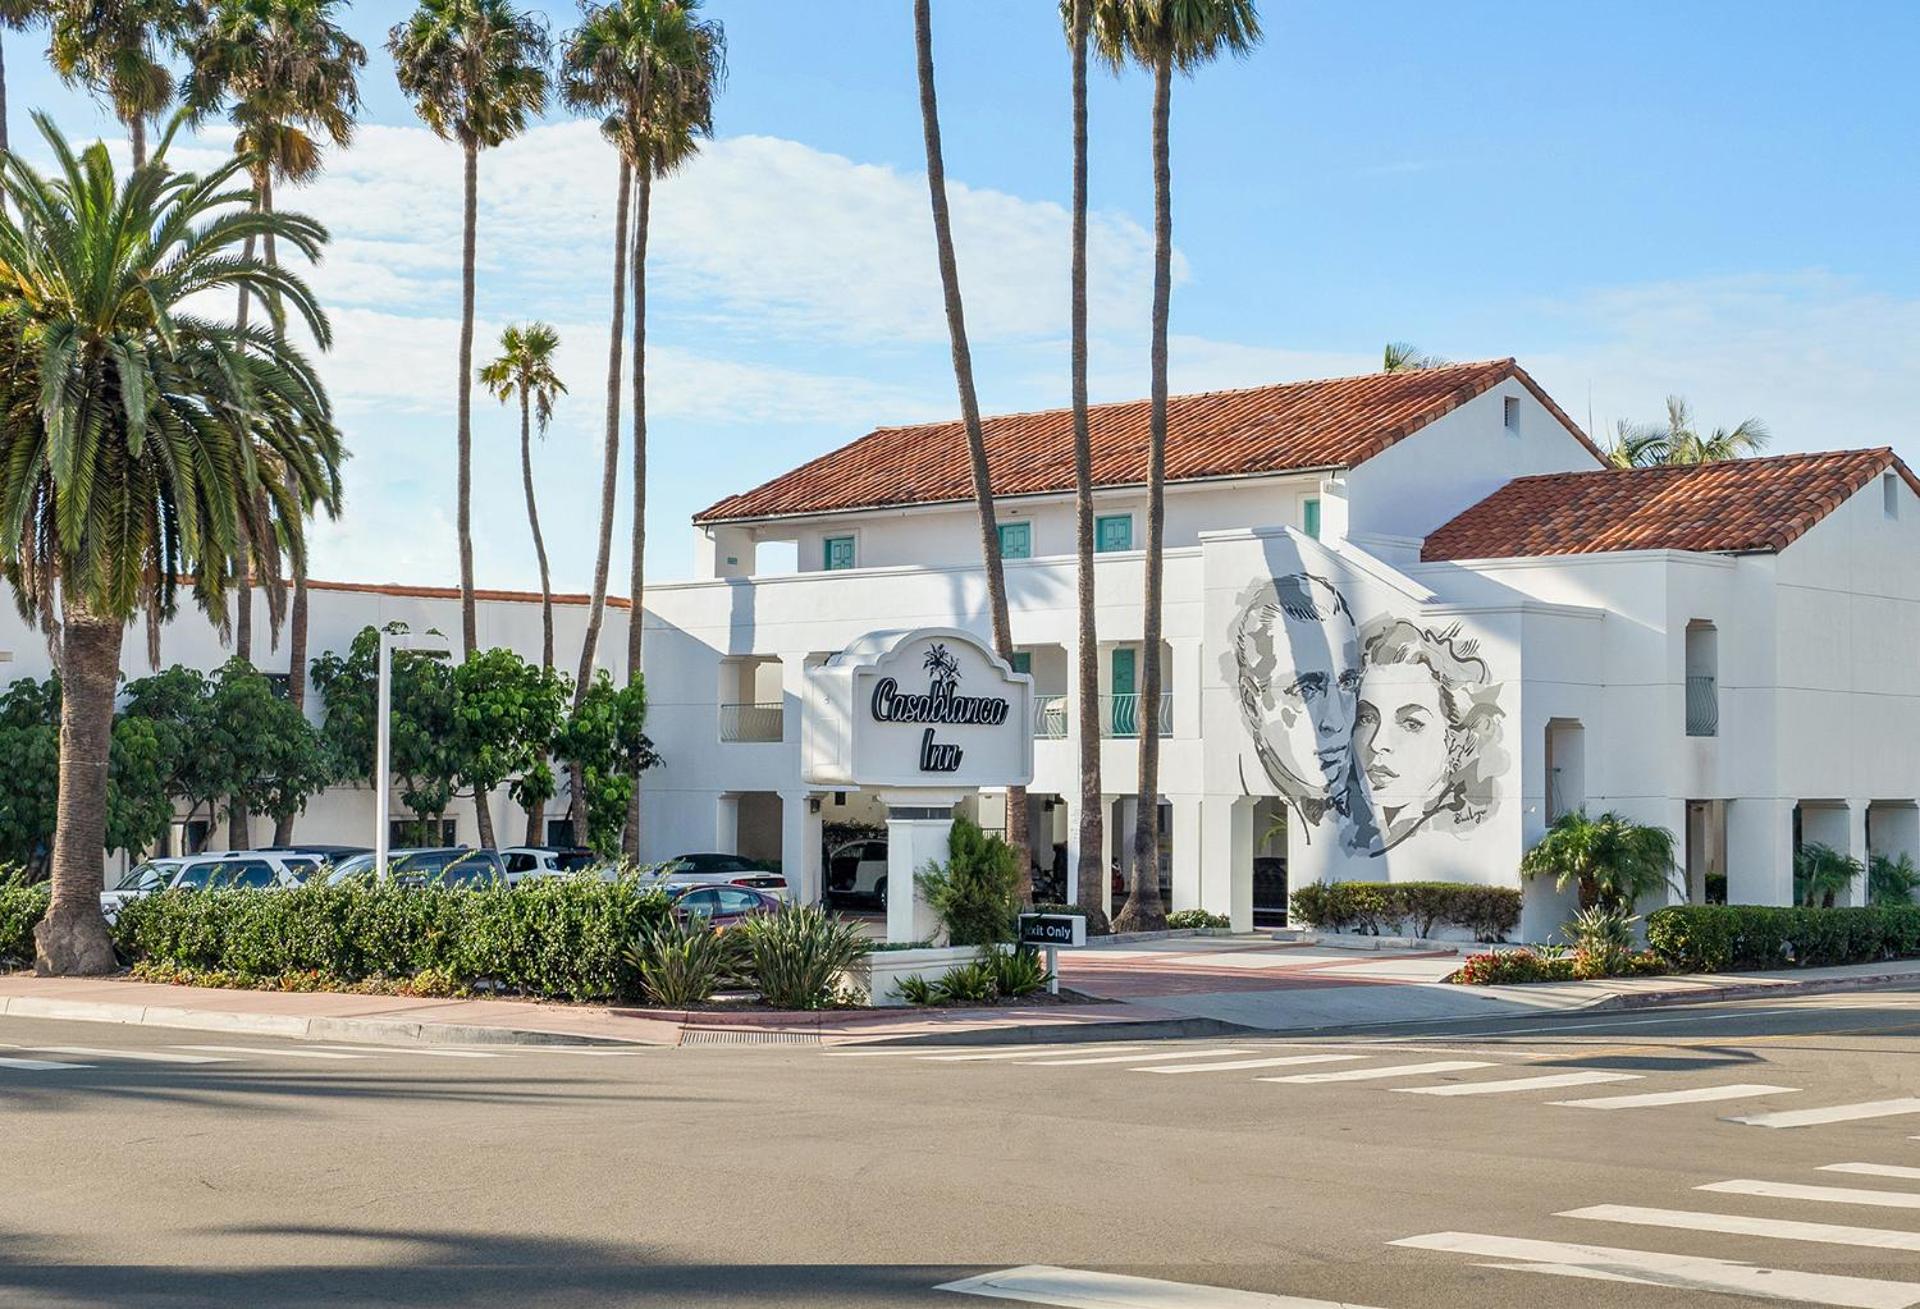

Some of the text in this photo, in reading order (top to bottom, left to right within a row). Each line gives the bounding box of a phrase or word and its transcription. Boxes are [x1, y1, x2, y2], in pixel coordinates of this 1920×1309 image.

[871, 677, 1009, 725] Casablanca
[919, 728, 963, 772] Inn
[1026, 924, 1071, 940] xit Only
